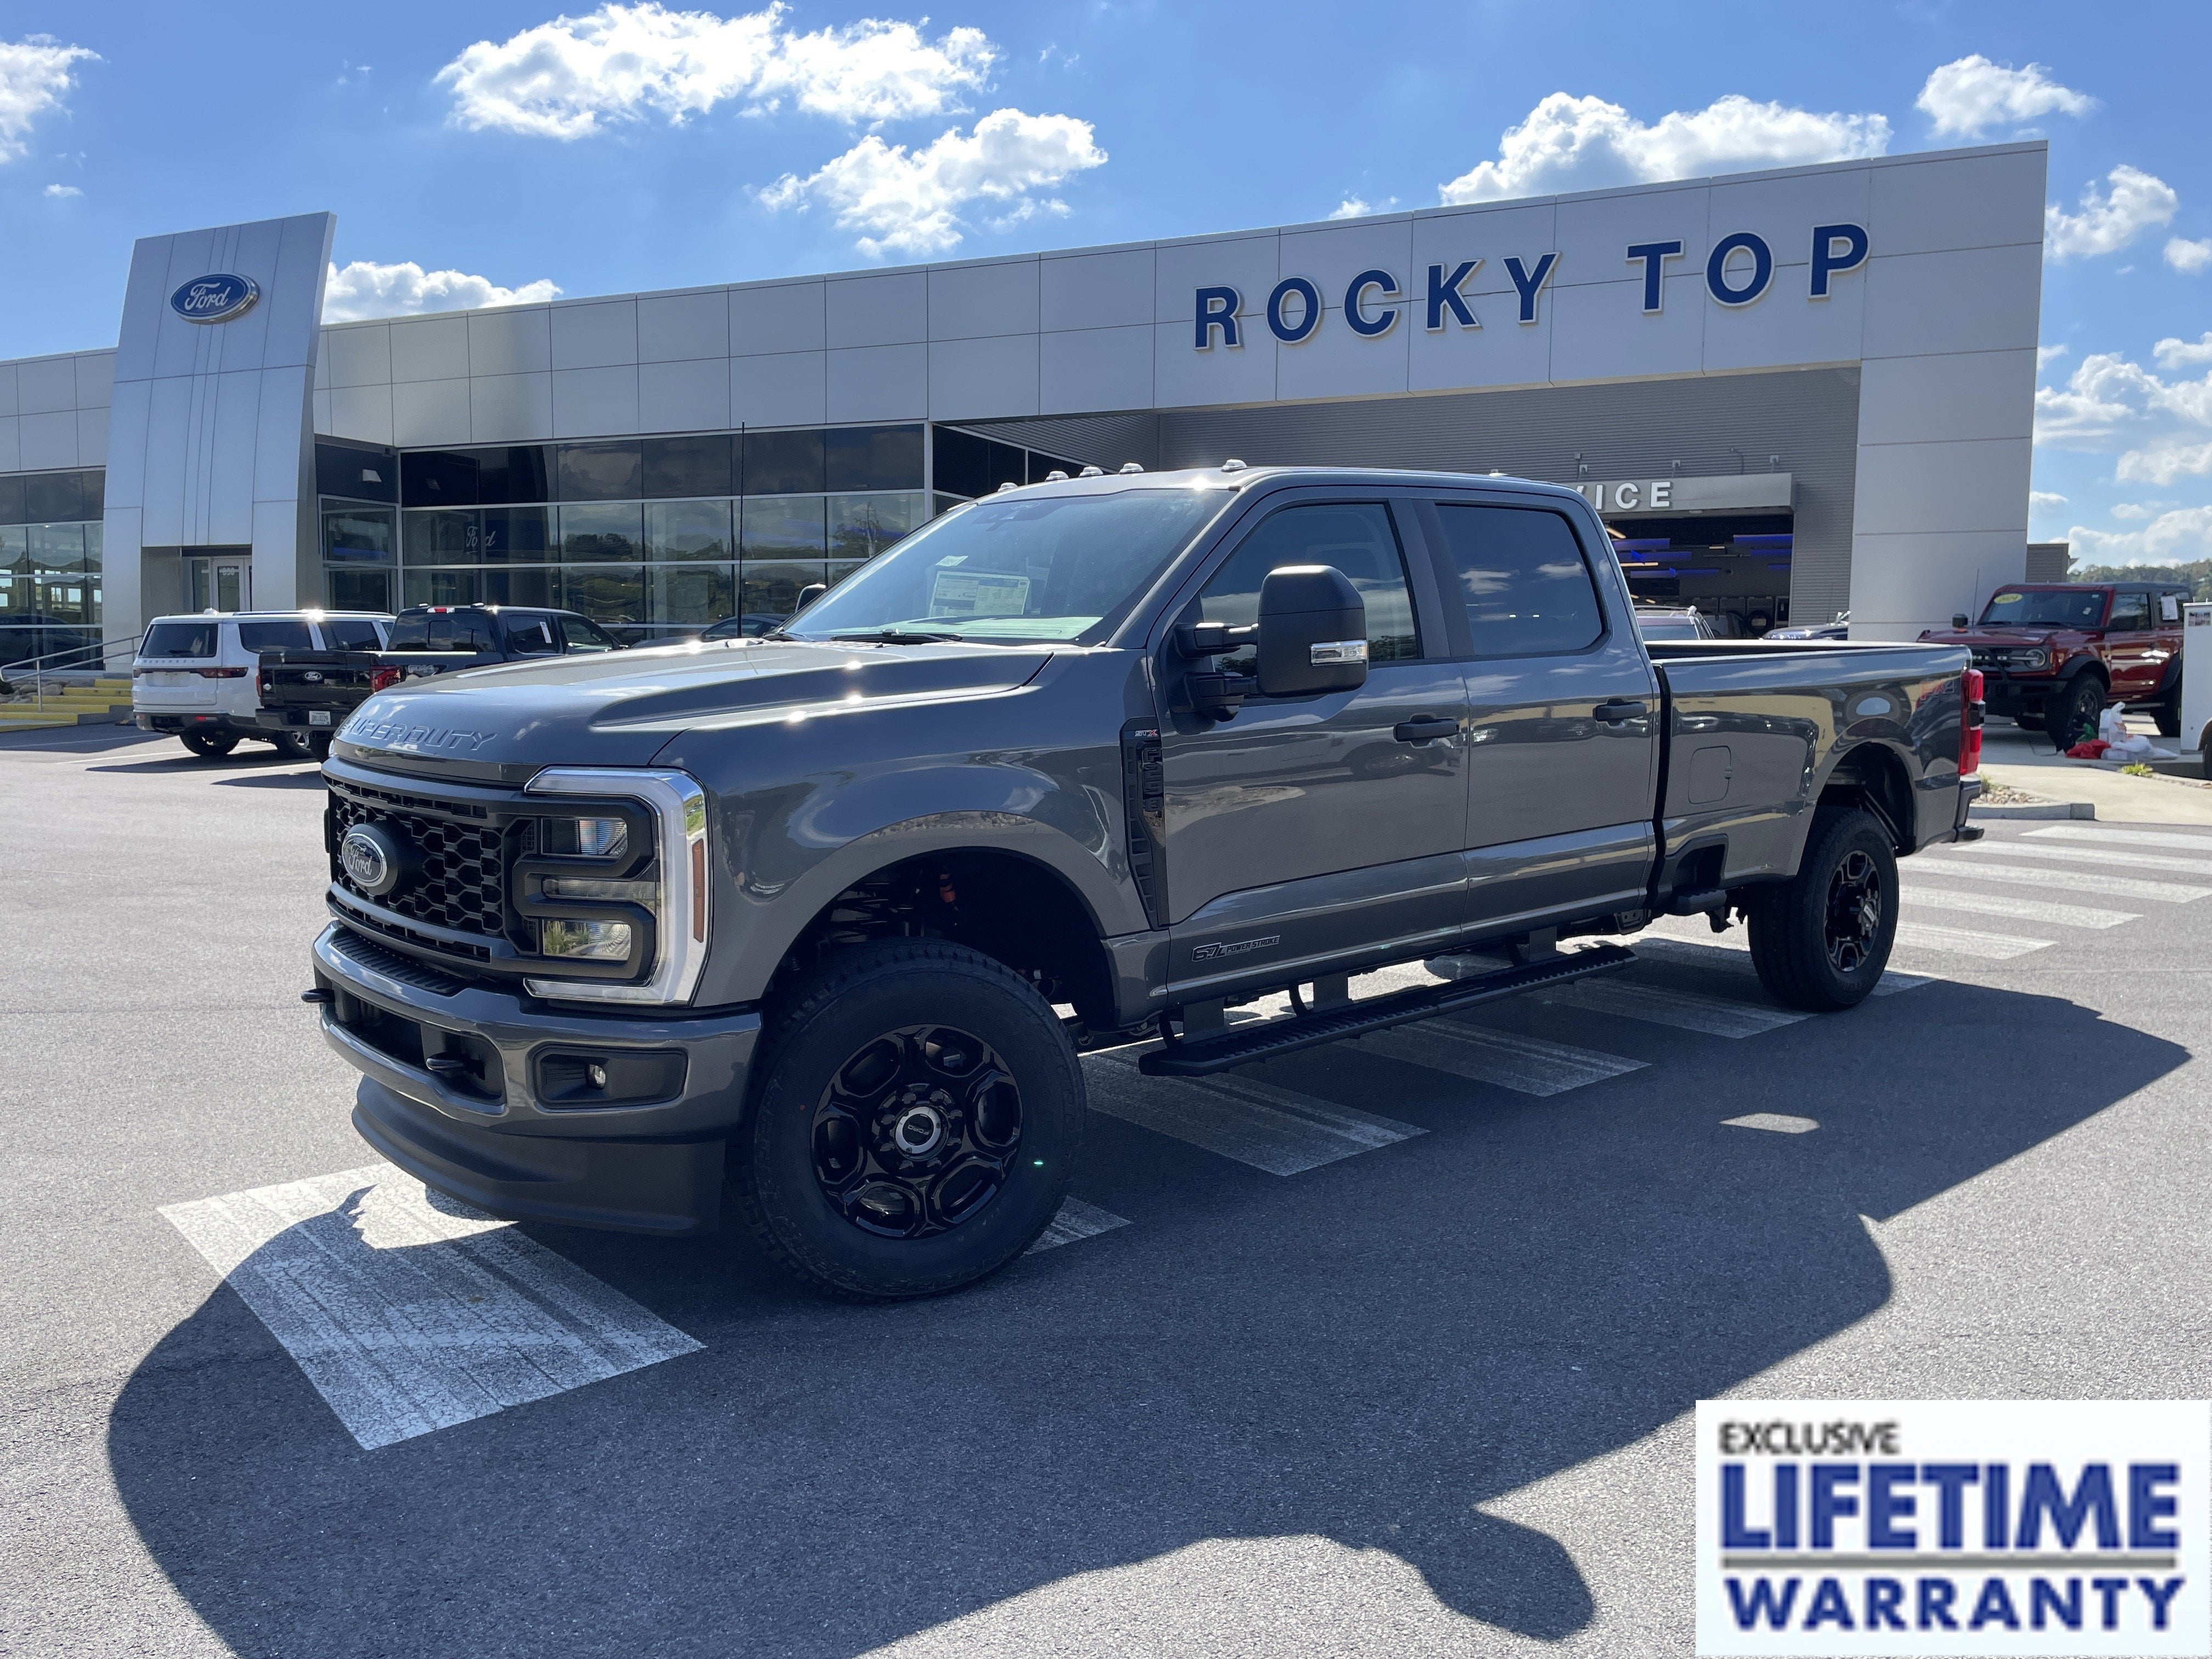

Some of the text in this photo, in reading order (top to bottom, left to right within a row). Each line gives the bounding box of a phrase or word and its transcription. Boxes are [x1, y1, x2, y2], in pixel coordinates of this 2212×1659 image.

[184, 283, 231, 311] Ford
[1193, 222, 1871, 349] ROCKY TOP
[466, 526, 496, 548] Fod
[403, 725, 498, 751] DUTY
[1135, 729, 1159, 737] STX
[349, 843, 373, 876] Ford
[1192, 942, 1226, 961] 6.7L
[1226, 942, 1251, 952] POWER
[1251, 936, 1279, 948] STROKE
